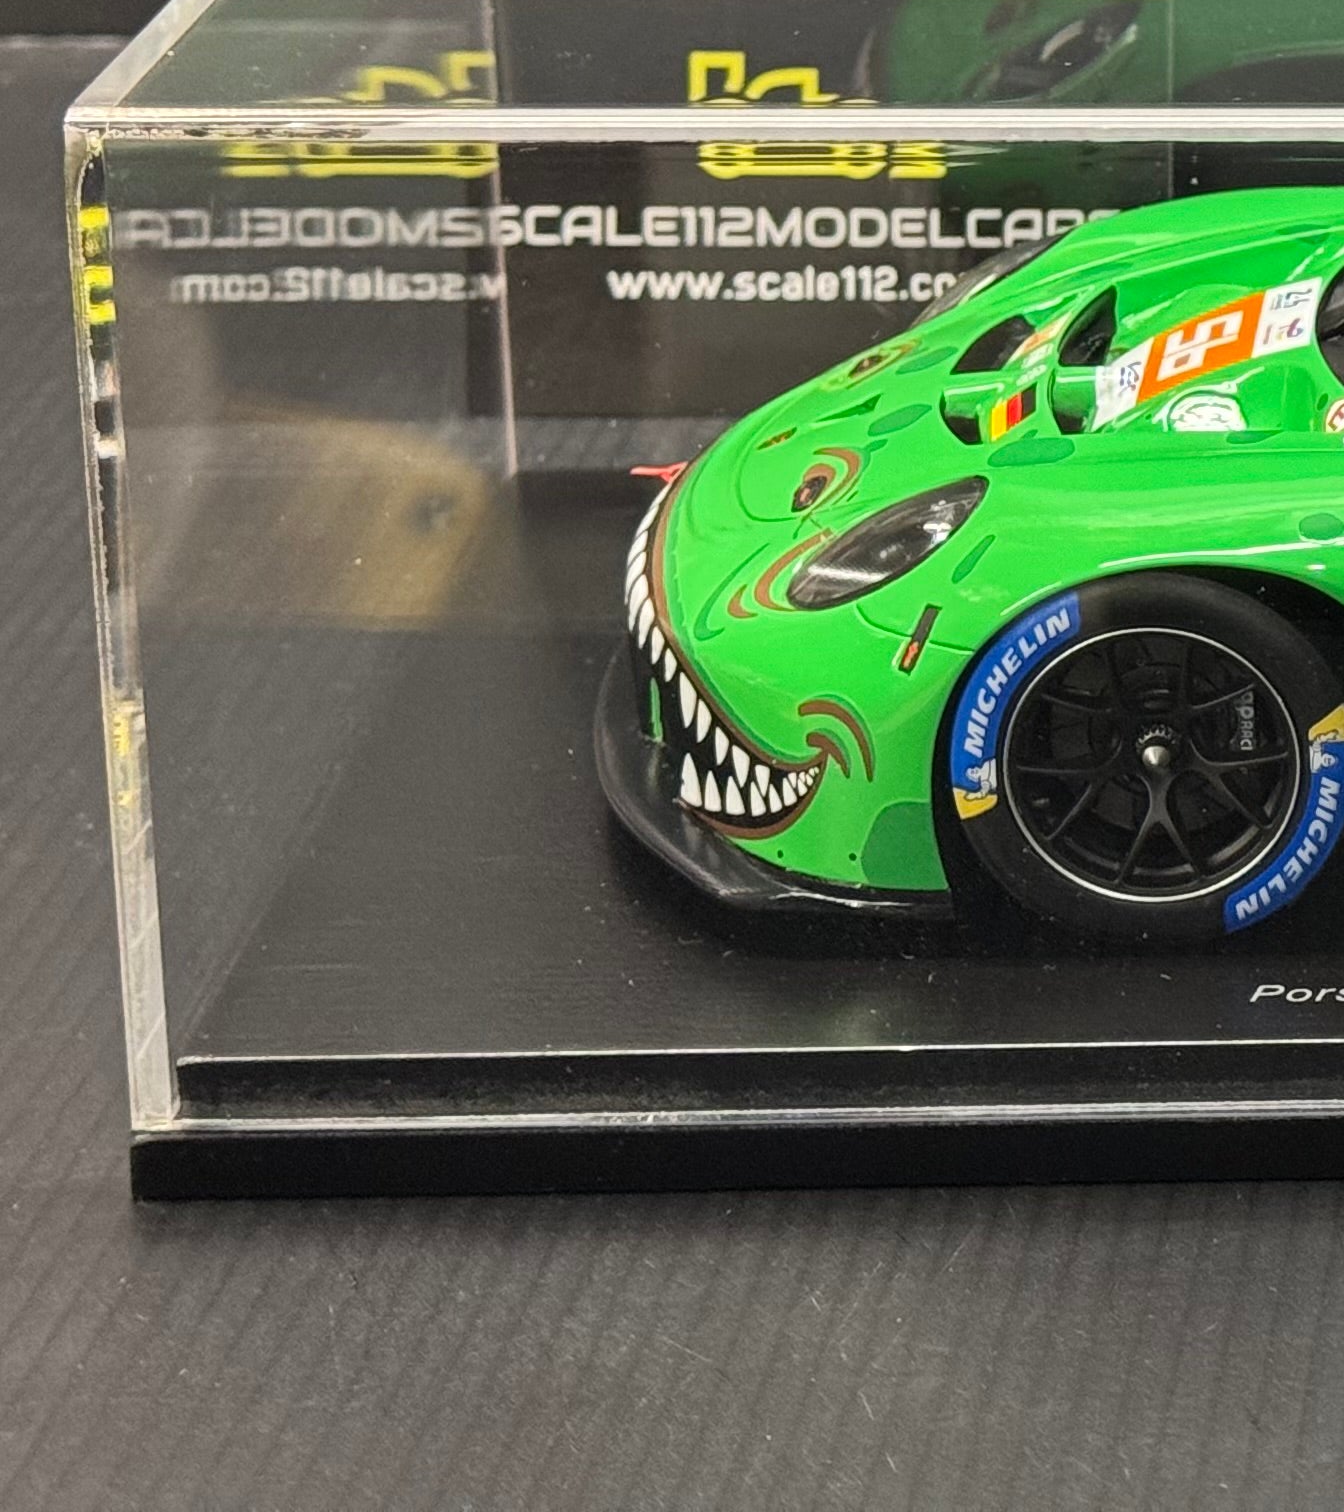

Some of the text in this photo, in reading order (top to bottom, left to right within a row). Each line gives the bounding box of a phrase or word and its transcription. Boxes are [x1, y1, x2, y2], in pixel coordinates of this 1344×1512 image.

[495, 206, 1122, 249] SCALE112MODELCAR
[962, 607, 1073, 758] MICHELIN
[1234, 776, 1342, 921] MICHELIN
